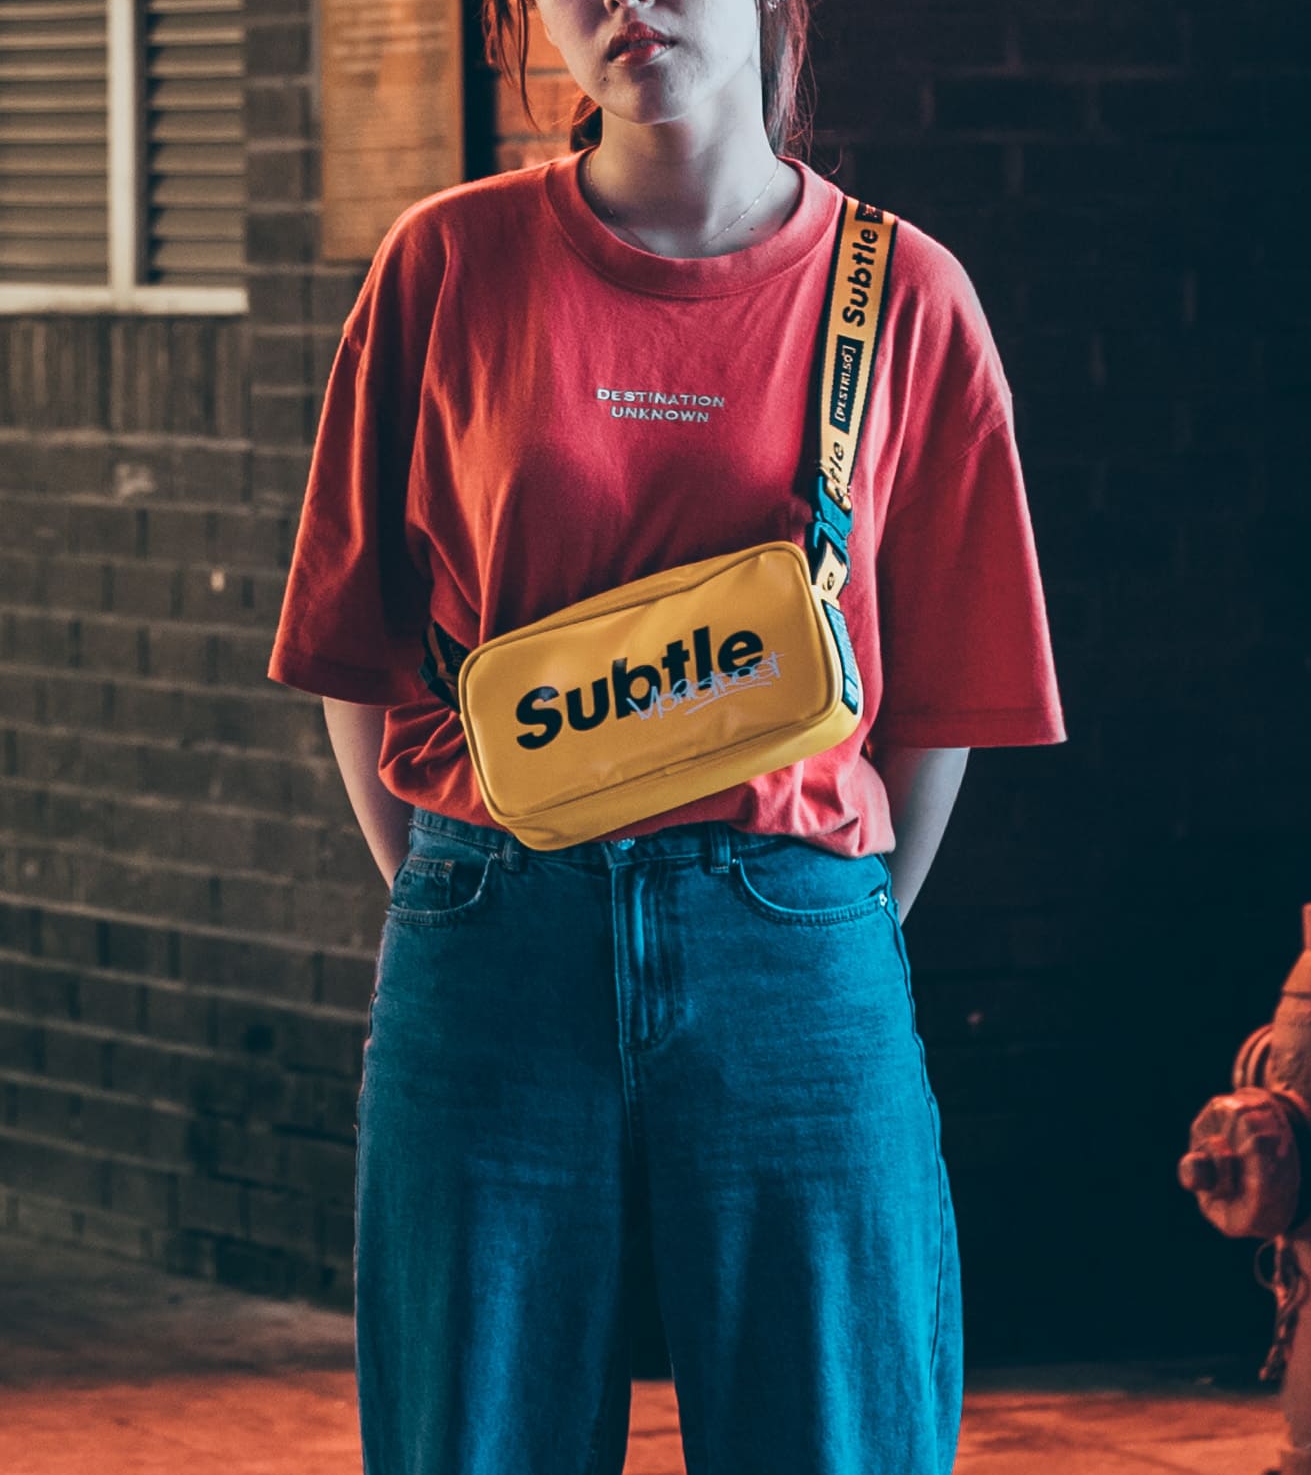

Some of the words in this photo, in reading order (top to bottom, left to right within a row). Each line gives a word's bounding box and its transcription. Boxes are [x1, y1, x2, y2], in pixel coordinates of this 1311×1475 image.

[842, 228, 879, 327] Subtle
[596, 388, 725, 408] DESTINATION
[611, 405, 709, 423] UNKNOWN
[515, 625, 764, 750] Subtle
